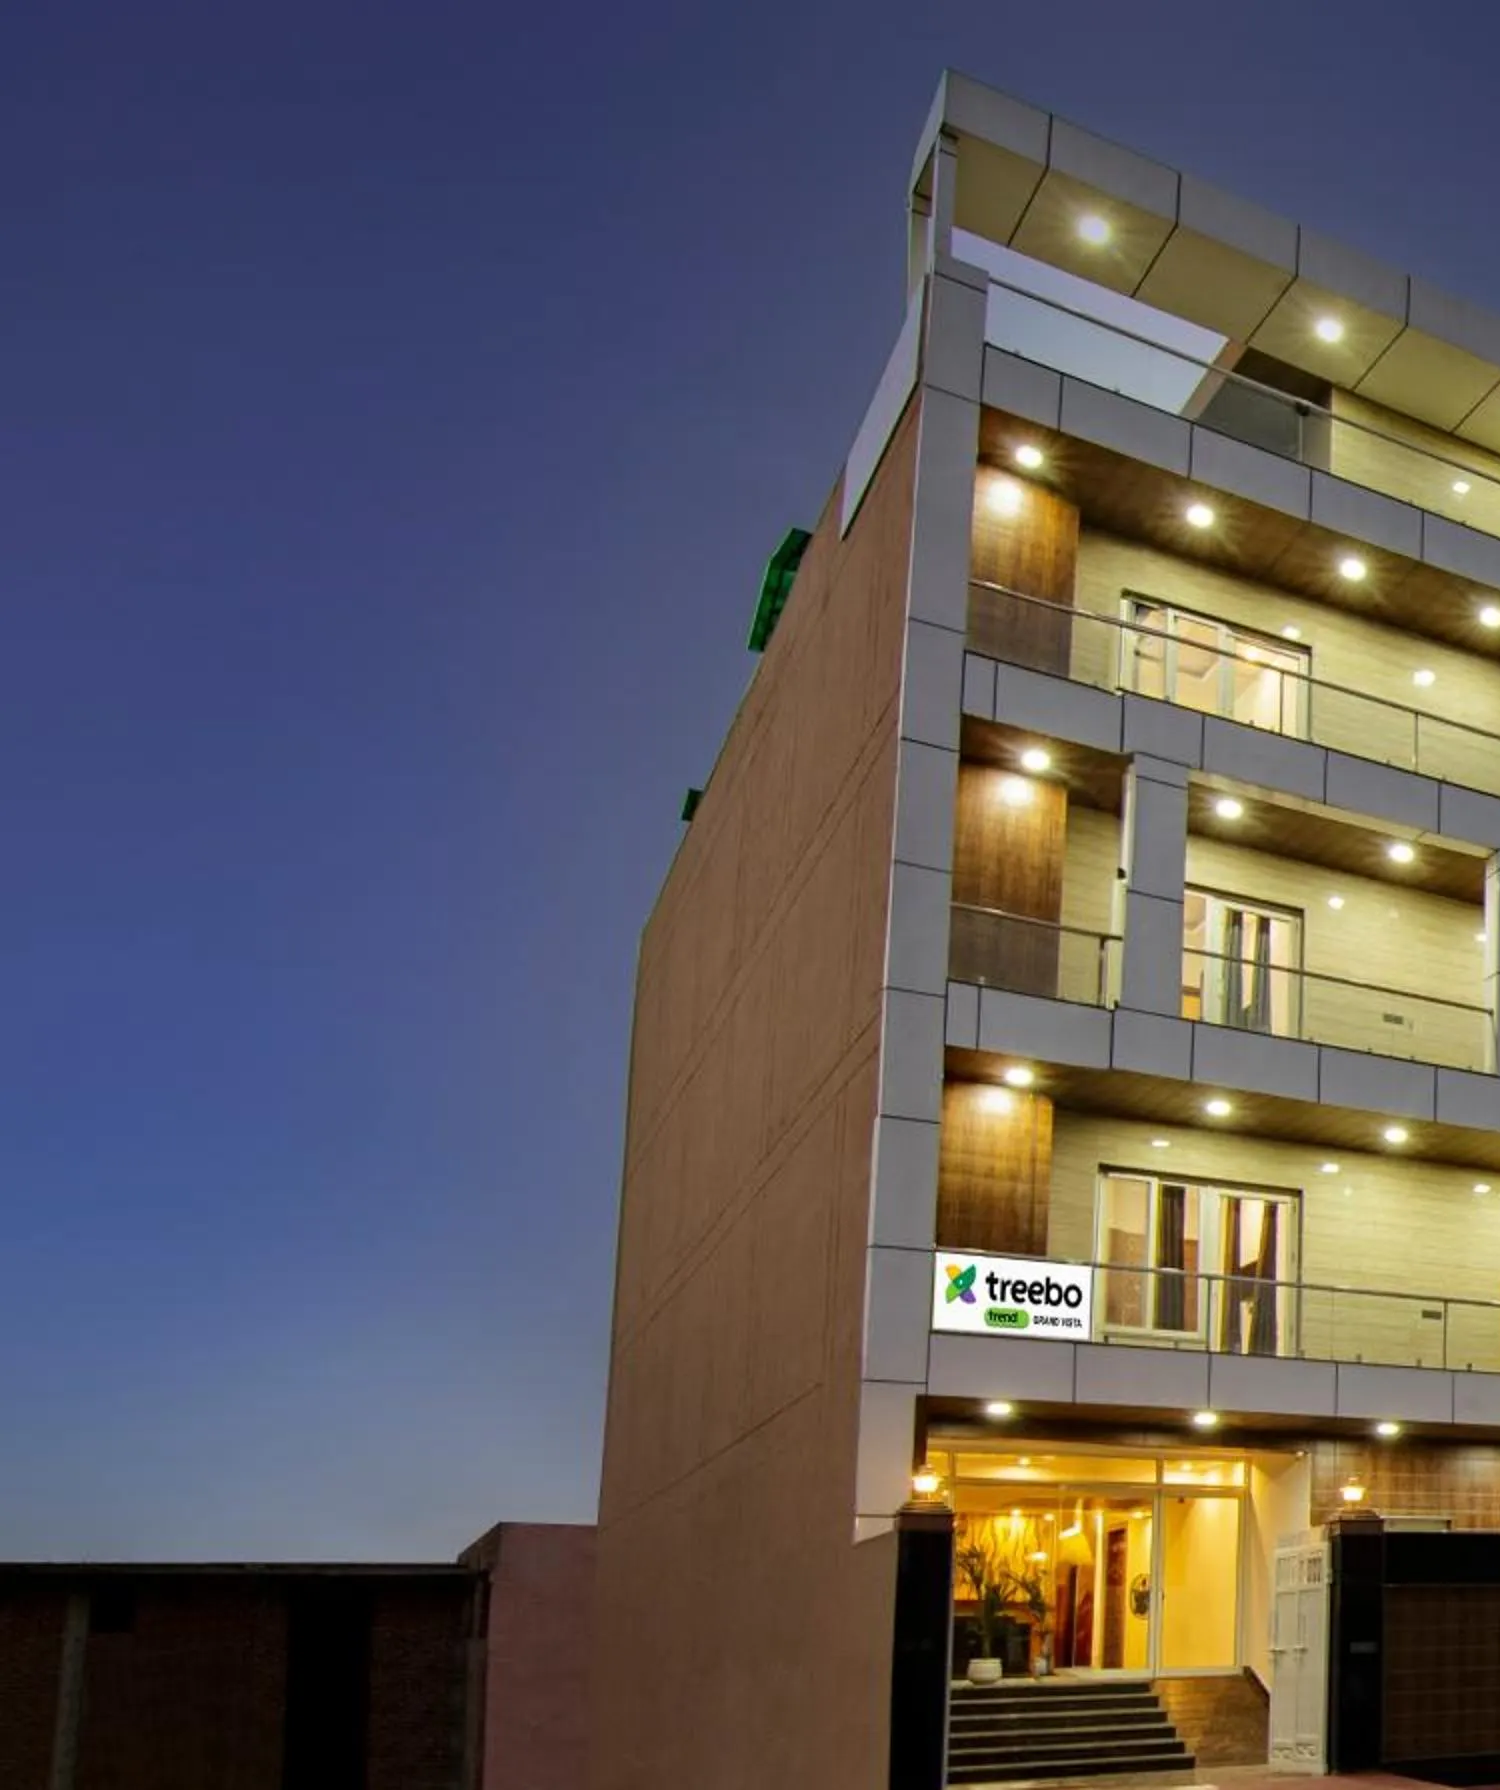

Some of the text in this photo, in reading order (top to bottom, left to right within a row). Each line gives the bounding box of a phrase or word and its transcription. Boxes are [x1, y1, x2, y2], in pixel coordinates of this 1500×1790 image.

[985, 1270, 1083, 1308] treebo
[988, 1309, 1019, 1323] trend
[1033, 1315, 1083, 1328] GRAND VISTA
